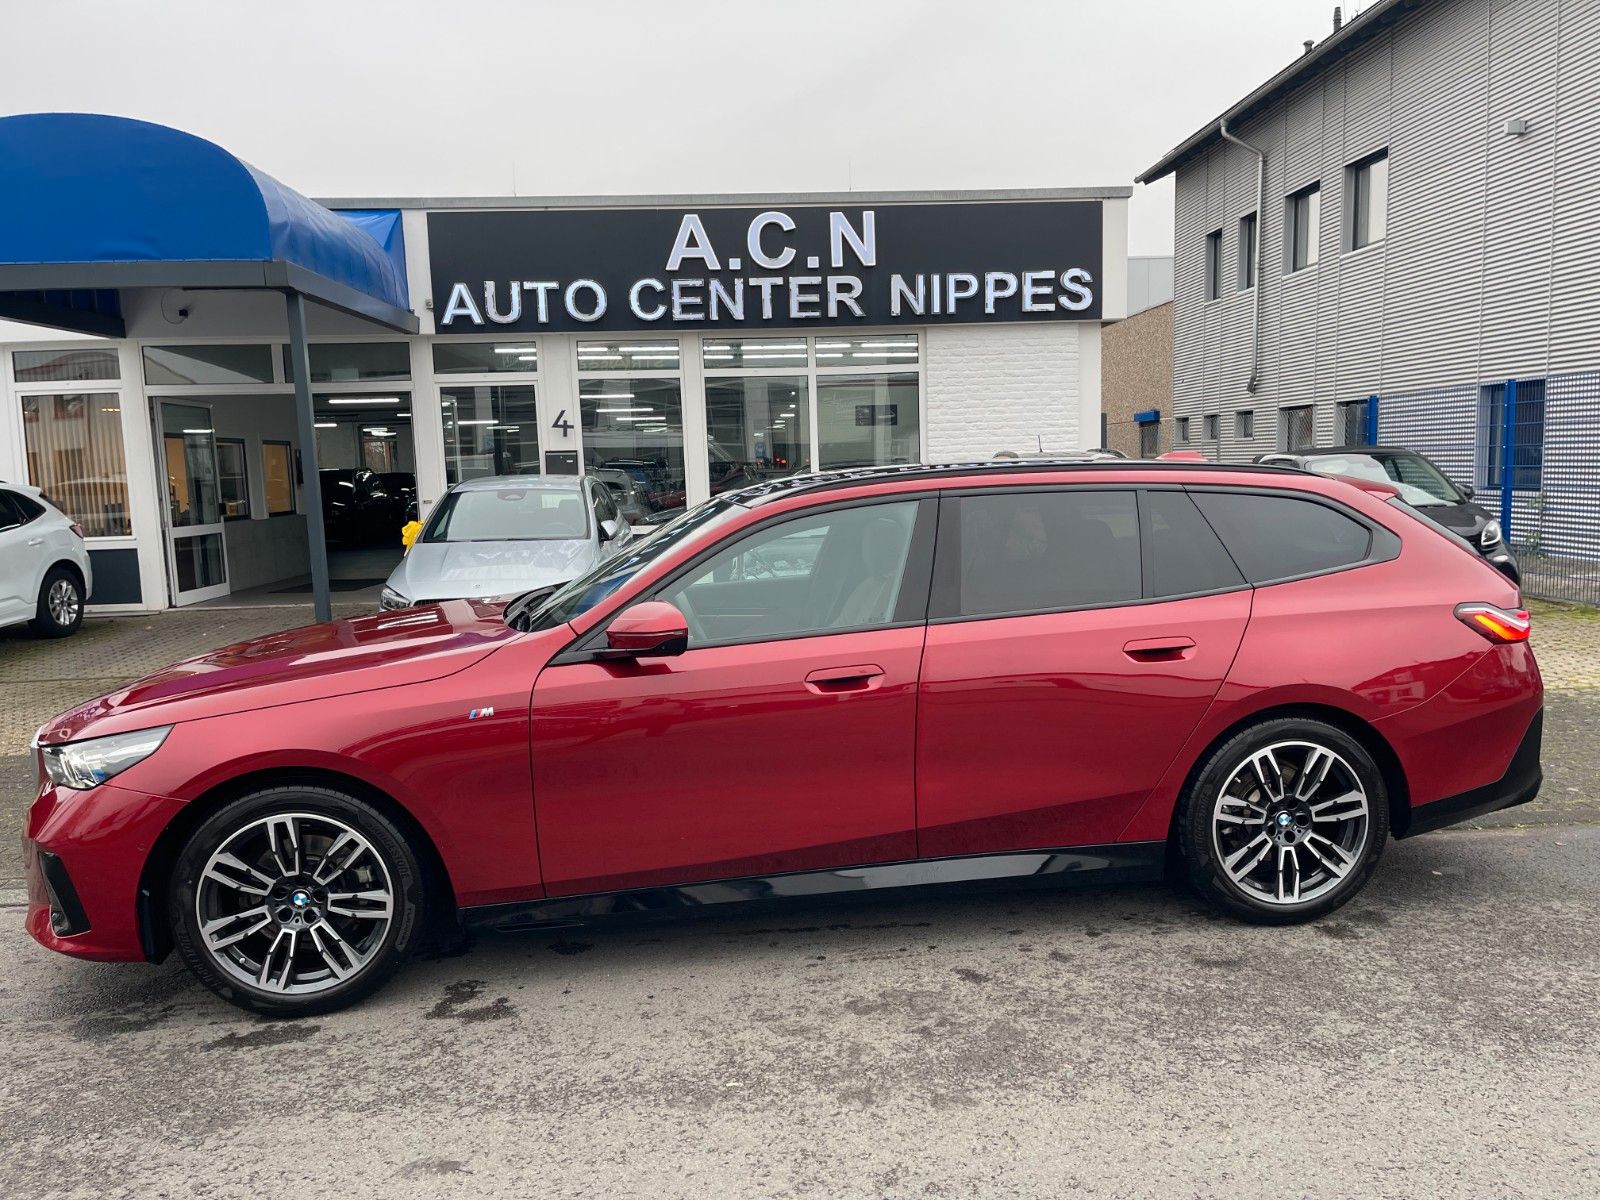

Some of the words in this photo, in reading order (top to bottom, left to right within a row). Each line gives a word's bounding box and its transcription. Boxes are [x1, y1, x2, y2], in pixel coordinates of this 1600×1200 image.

[665, 210, 877, 271] A.C.N
[441, 278, 608, 325] AUTO
[628, 274, 867, 322] CENTER
[890, 267, 1094, 318] NIPPES
[551, 409, 575, 438] 4
